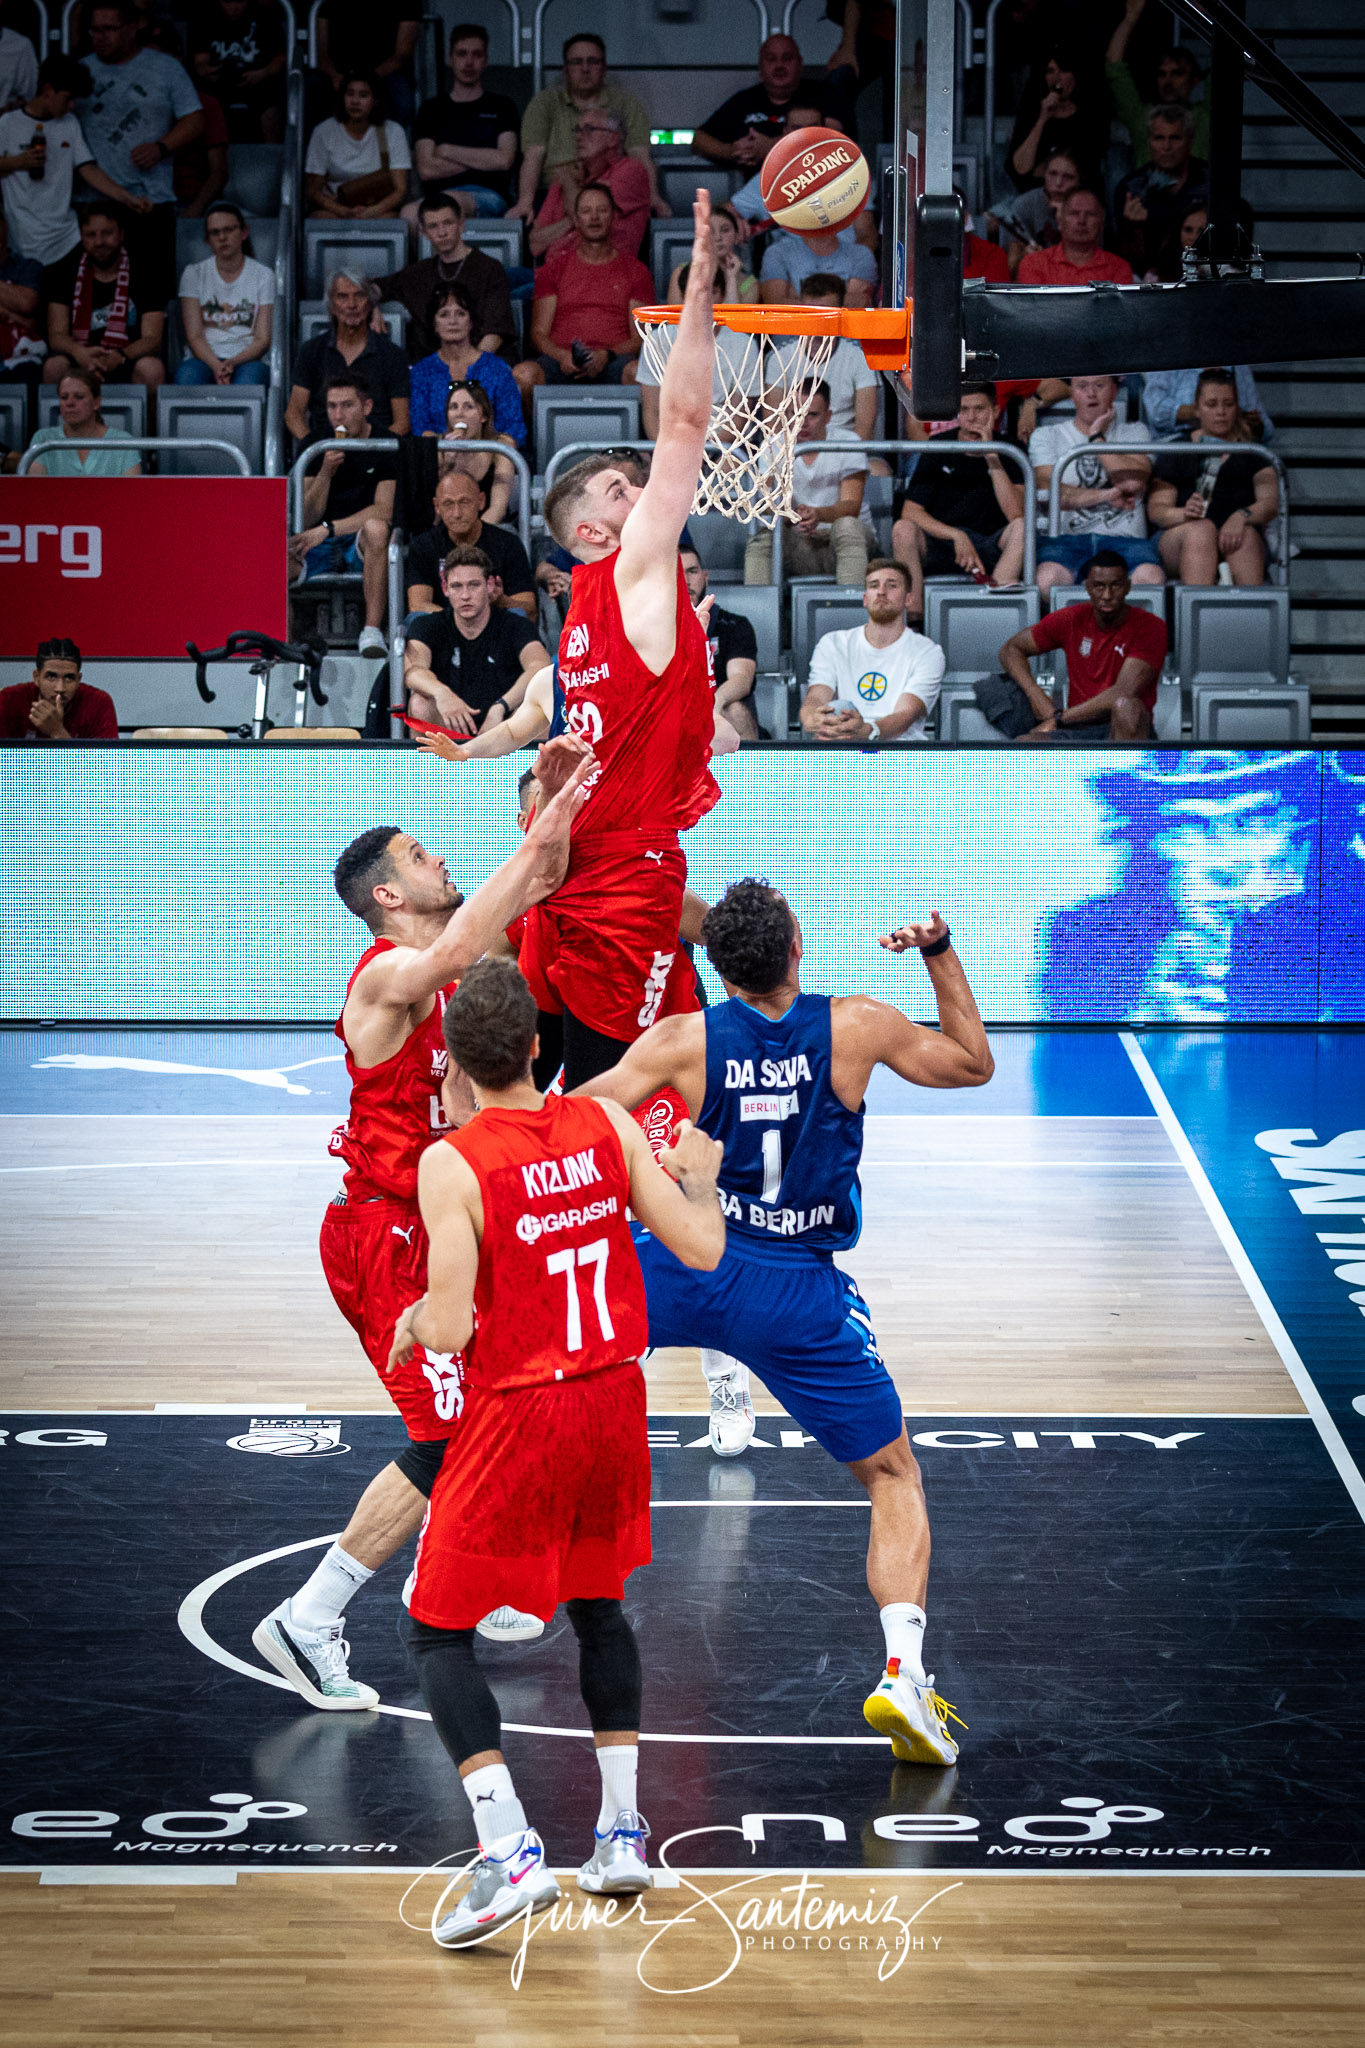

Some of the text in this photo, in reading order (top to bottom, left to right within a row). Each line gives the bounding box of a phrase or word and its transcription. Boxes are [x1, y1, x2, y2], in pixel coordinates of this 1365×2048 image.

[780, 146, 851, 203] SPALDING
[0, 524, 102, 579] erg
[725, 1059, 756, 1088] DA
[744, 1103, 778, 1113] BERLIN
[521, 1148, 603, 1199] KYZLINK
[762, 1129, 782, 1204] 1
[750, 1203, 835, 1236] BERLIN
[546, 1237, 615, 1352] 77
[421, 1347, 465, 1421] SIX
[0, 1428, 108, 1447] G
[911, 1430, 1206, 1449] CITY
[112, 1840, 399, 1854] Magnequench
[986, 1844, 1271, 1857] Magnequench
